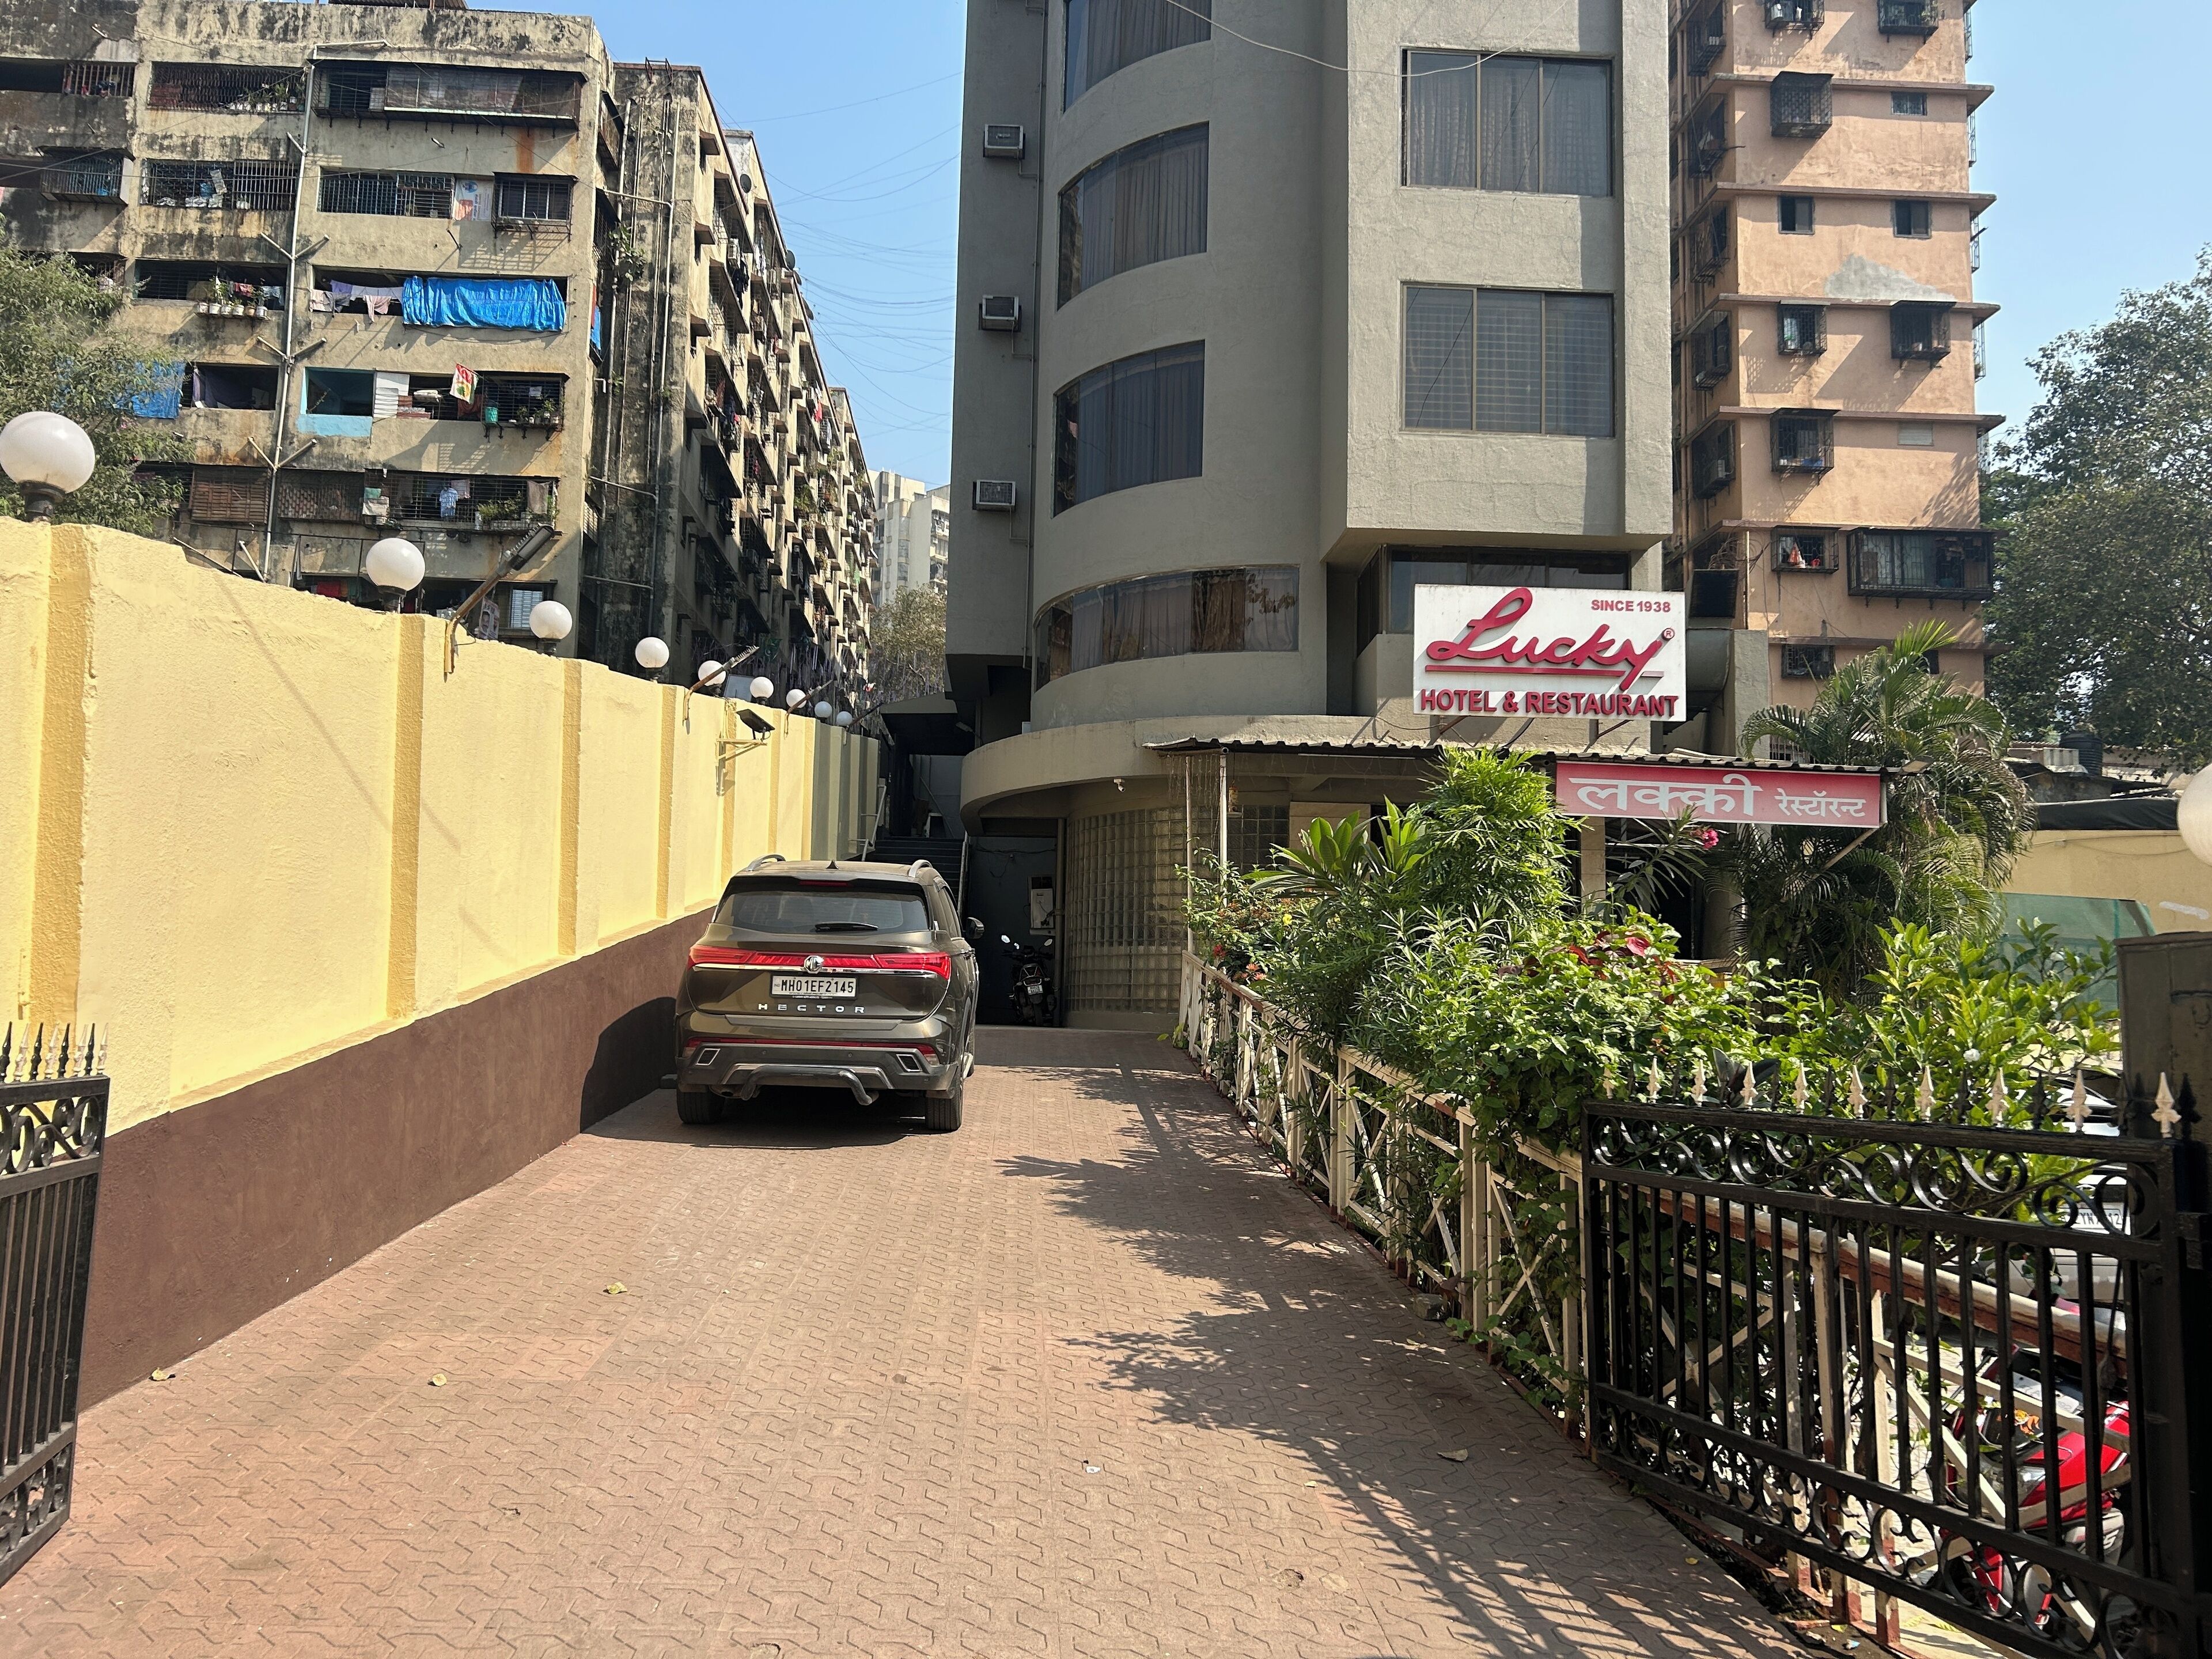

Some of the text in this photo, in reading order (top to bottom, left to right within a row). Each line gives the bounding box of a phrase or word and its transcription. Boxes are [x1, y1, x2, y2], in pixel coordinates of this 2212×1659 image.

[1591, 599, 1671, 613] SINCE 1938
[1426, 587, 1663, 691] Lucky
[1421, 689, 1679, 717] HOTEL & RESTAURANT
[1568, 773, 1763, 816] लक्की
[781, 979, 854, 993] MH01EF2145
[757, 1003, 865, 1014] HECTOR
